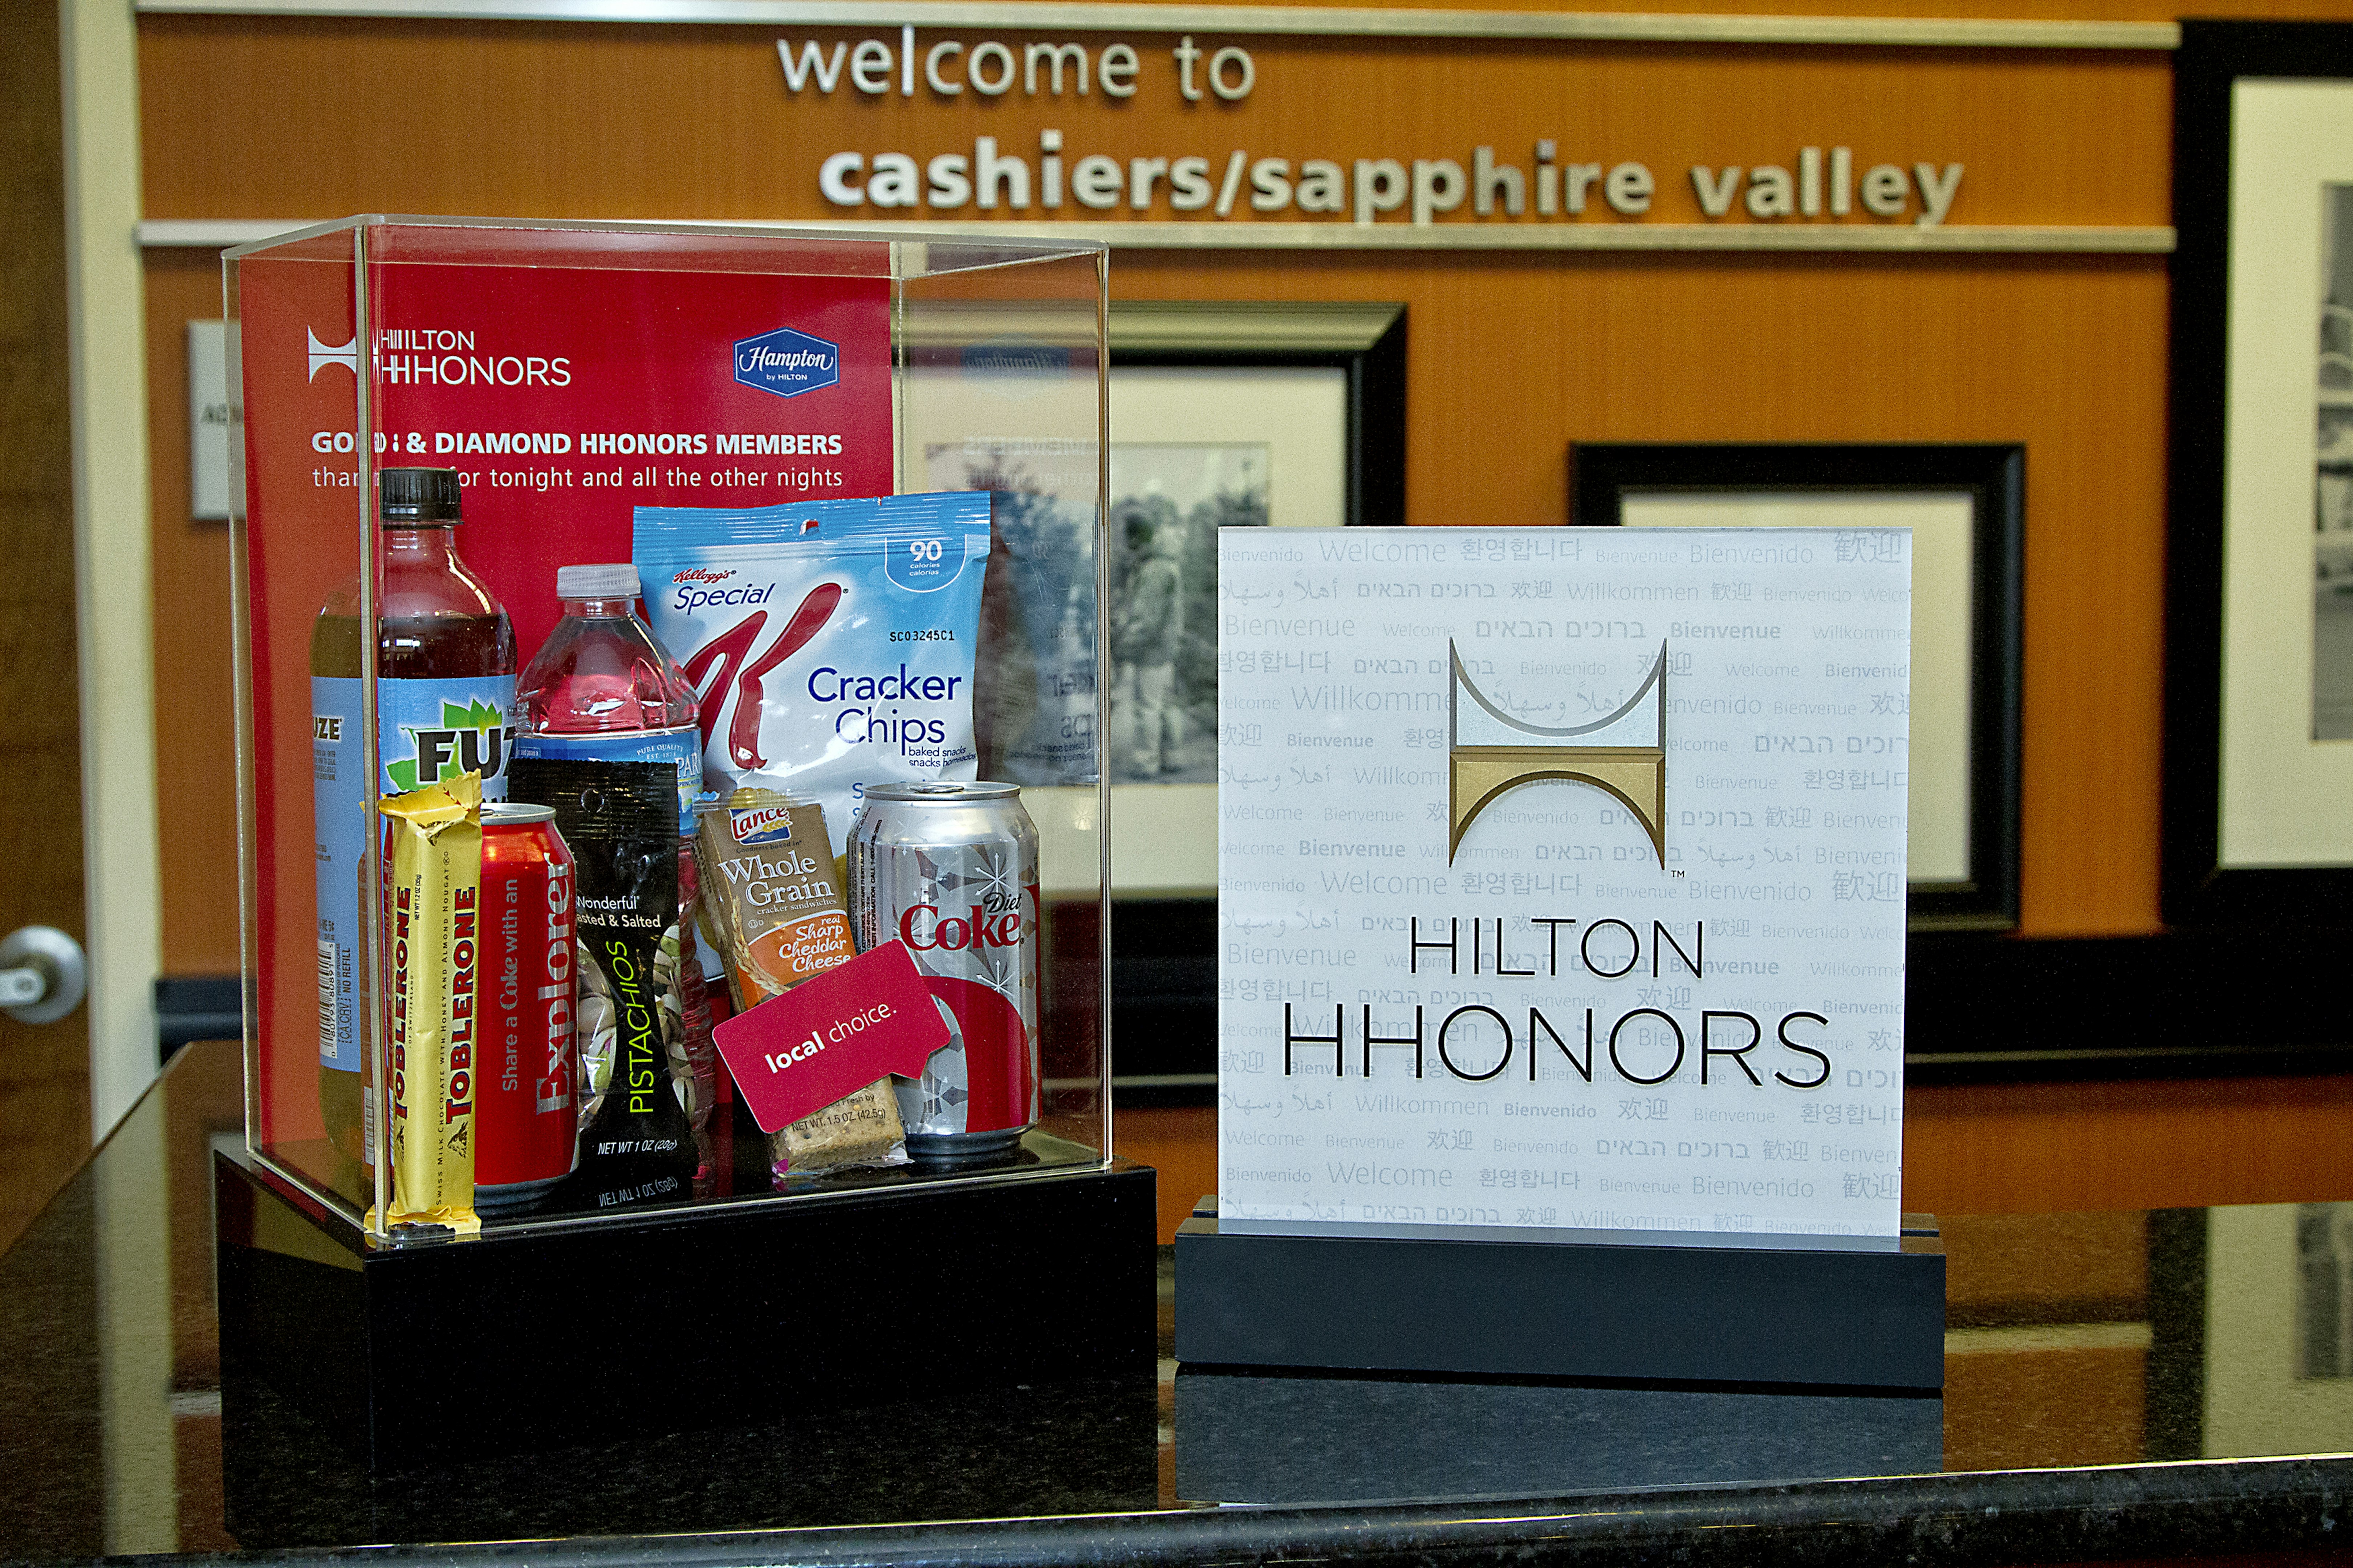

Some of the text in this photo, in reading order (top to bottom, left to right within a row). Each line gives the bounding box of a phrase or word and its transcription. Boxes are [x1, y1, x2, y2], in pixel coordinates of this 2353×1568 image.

[776, 25, 1257, 100] welcome to
[820, 129, 1963, 226] cashiers/sapphire valley
[739, 346, 833, 371] Hampton
[406, 432, 427, 453] &
[435, 432, 571, 454] DIAMOND
[580, 433, 707, 455] HHONORS
[716, 434, 843, 455] MEMBERS
[491, 467, 573, 492] tonight
[582, 467, 622, 487] and
[632, 467, 657, 486] all
[666, 467, 705, 487] the
[710, 467, 767, 487] other
[777, 467, 843, 491] nights
[909, 540, 943, 562] 90
[1319, 538, 1446, 563] Welcome
[1461, 538, 1582, 562] 환영합니다
[1595, 548, 1678, 563] Bienvenue
[1690, 544, 1813, 564] Bienvenido
[673, 568, 731, 584] Kellogg's
[673, 583, 776, 615] Special
[1510, 580, 1553, 599] 欢迎
[1566, 581, 1699, 601] Willkommen
[1763, 587, 1852, 603] Bienvenido
[1225, 615, 1356, 636] Bienvenue
[1383, 623, 1456, 637] Welcome
[1670, 621, 1781, 639] Bienvenue
[889, 630, 955, 642] SC03245C1
[684, 582, 842, 769] K
[1520, 661, 1607, 676] Bienvenido
[1725, 663, 1800, 677] Welcome
[808, 663, 962, 702] Cracker
[1773, 700, 1857, 716] Bienvenue
[835, 708, 945, 756] Chips
[1287, 732, 1374, 748] Bienvenue
[909, 745, 967, 757] baked snacks
[909, 758, 940, 767] snacks
[1695, 774, 1778, 790] Bienvenue
[1224, 804, 1303, 820] Welcome
[1324, 807, 1405, 822] Bienvenue
[1492, 809, 1579, 824] Bienvenido
[732, 807, 787, 839] Lance
[1299, 839, 1406, 858] Bienvenue
[718, 850, 817, 884] Whole
[745, 877, 834, 907] Grain
[1321, 869, 1448, 895] Welcome
[1461, 872, 1582, 896] 환영합니다
[1595, 884, 1678, 899] Bienvenue
[1689, 880, 1812, 900] Bienvenido
[757, 898, 837, 915] cracker sandwiches
[983, 892, 1021, 913] Diet
[609, 914, 619, 926] &
[621, 914, 662, 927] Salted
[821, 916, 840, 925] real
[899, 904, 1021, 951] Coke
[796, 924, 844, 942] Sharp
[779, 938, 846, 959] Cheddar
[1227, 943, 1357, 966] Bienvenue
[1411, 916, 1702, 978] HILTON
[342, 948, 351, 993] NO REFILL
[792, 955, 851, 973] Cheese
[500, 879, 518, 1091] Share a Coke with an
[536, 852, 577, 1116] Explorer
[395, 886, 410, 1120] TOBLERONE
[446, 887, 476, 1125] TOBLERONE
[606, 939, 654, 1113] PISTACHIOS
[764, 1003, 897, 1074] local choice.
[1285, 1003, 1830, 1088] HHONORS
[865, 1094, 875, 1102] by
[1355, 1094, 1489, 1115] Willkommen
[1504, 1102, 1597, 1118] Bienvenido
[1694, 1107, 1776, 1123] Bienvenue
[792, 1120, 808, 1132] NET
[809, 1118, 826, 1128] WT.
[827, 1115, 840, 1125] 1.5
[598, 1142, 617, 1155] NET
[618, 1141, 634, 1153] WT
[635, 1141, 640, 1152] 1
[641, 1139, 655, 1151] OZ
[1224, 1129, 1305, 1147] Welcome
[1325, 1134, 1405, 1150] Bienvenue
[1225, 1167, 1312, 1183] Bienvenido
[1326, 1161, 1453, 1187] Welcome
[1479, 1168, 1581, 1190] 환영합니다
[1599, 1178, 1681, 1194] Bienvenue
[1692, 1176, 1814, 1198] Bienvenido
